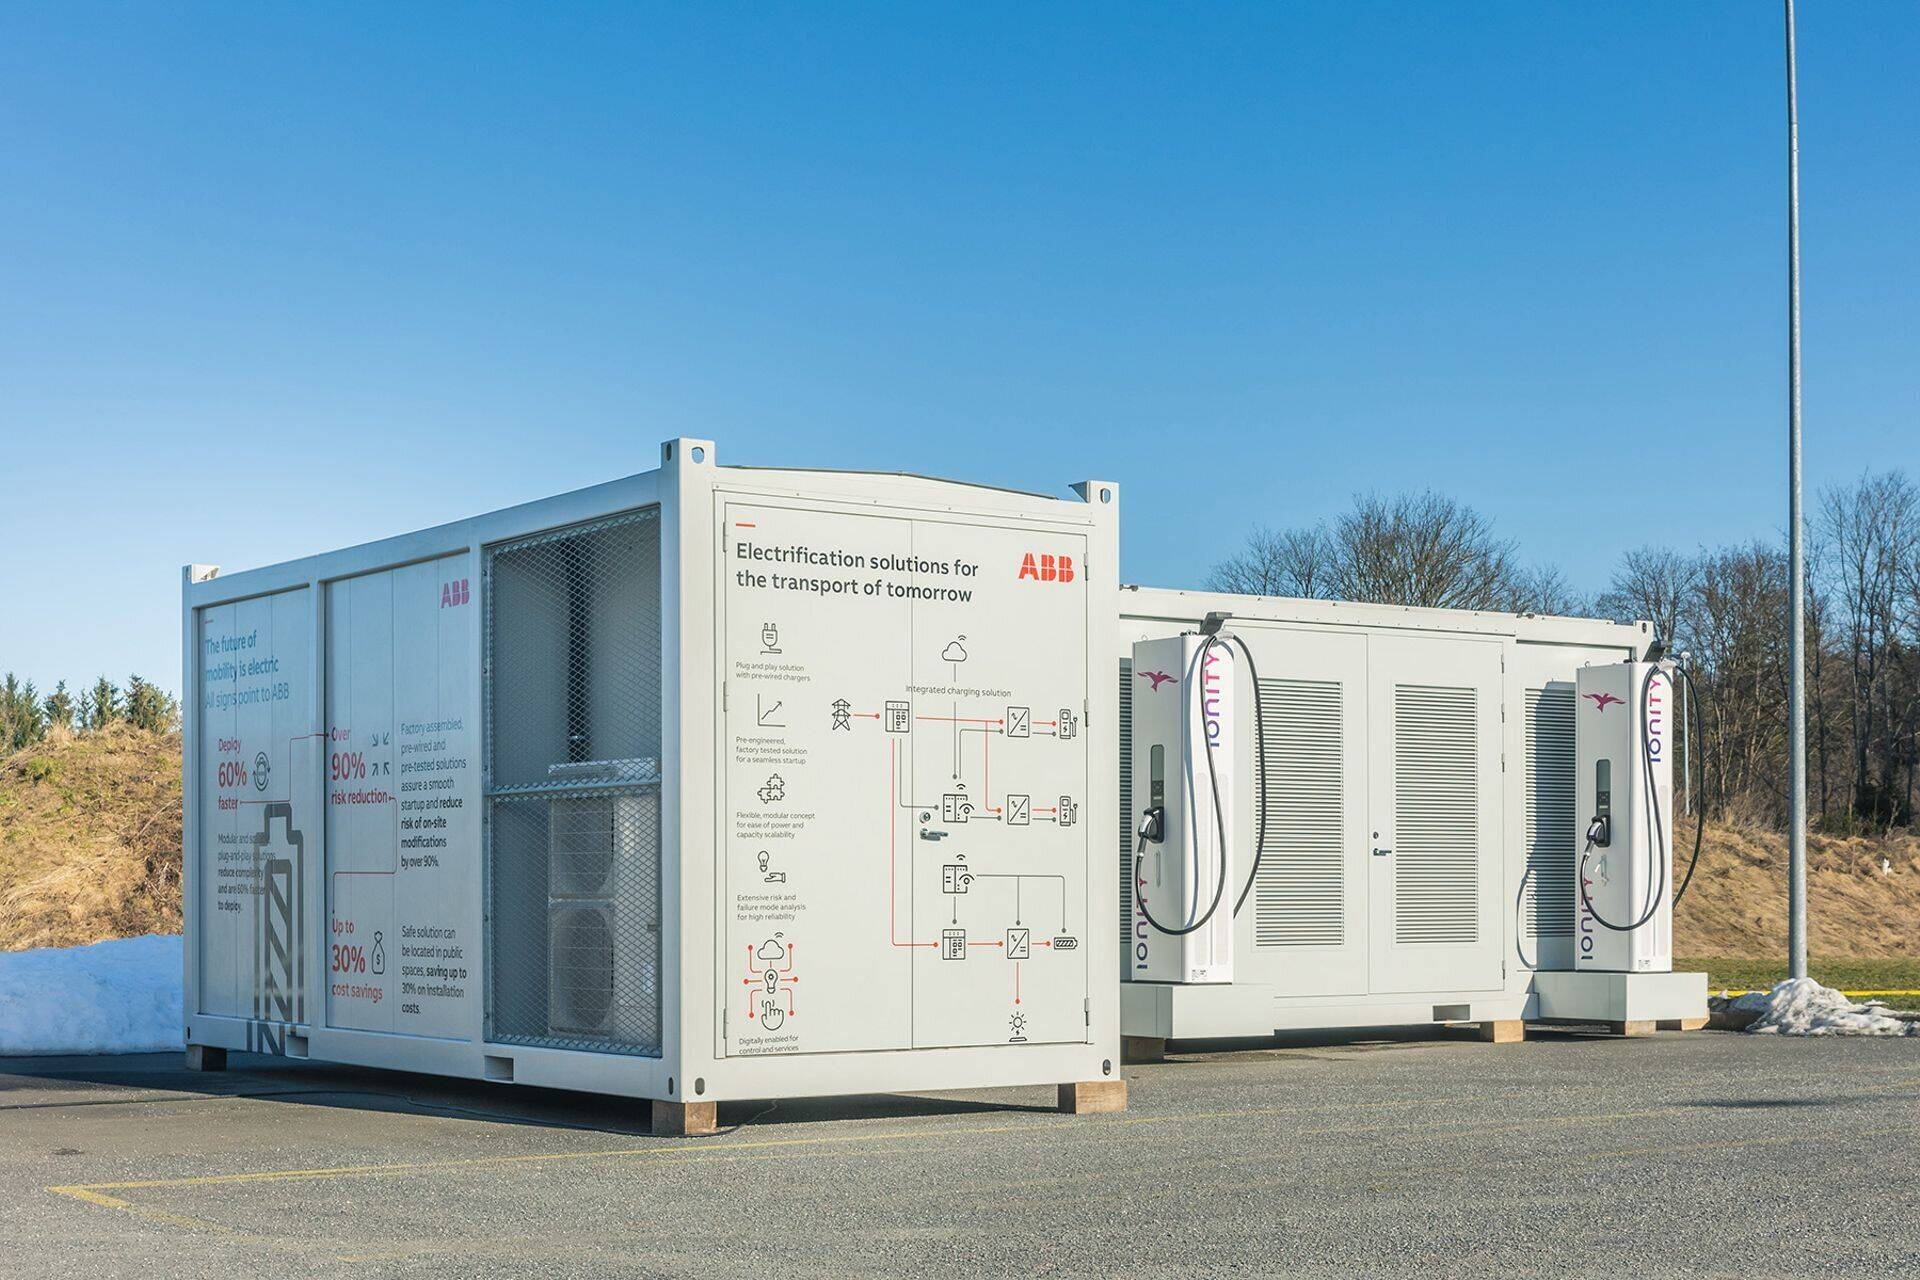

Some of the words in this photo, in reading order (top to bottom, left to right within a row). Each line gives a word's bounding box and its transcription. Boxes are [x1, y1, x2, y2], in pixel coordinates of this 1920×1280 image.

[736, 542, 865, 569] Electrification
[869, 552, 950, 575] solutions
[954, 559, 979, 577] for
[1018, 552, 1075, 583] ABB
[441, 578, 471, 609] ABB
[736, 570, 767, 588] the
[771, 572, 859, 596] transport
[863, 579, 882, 596] of
[886, 583, 973, 603] tomorrow
[205, 638, 219, 655] The
[221, 635, 246, 654] future
[247, 629, 257, 648] of
[206, 662, 237, 682] mobility
[239, 660, 247, 678] is
[248, 655, 278, 676] electric
[736, 661, 750, 671] Plug
[751, 662, 764, 670] and
[764, 662, 778, 672] play
[779, 664, 805, 672] solution
[736, 671, 750, 679] with
[751, 672, 782, 681] pre-wired
[783, 673, 811, 682] chargers
[205, 691, 215, 708] All
[216, 690, 237, 712] signs
[238, 686, 259, 706] point
[261, 686, 271, 703] to
[271, 682, 289, 700] ABB
[905, 684, 945, 698] Integrated
[946, 687, 981, 698] charging
[982, 688, 1012, 698] solution
[1204, 648, 1220, 748] IONITY
[1649, 678, 1661, 763] IONITY
[331, 725, 351, 742] Over
[401, 723, 424, 737] Factory
[218, 736, 241, 755] Deploy
[401, 741, 431, 755] pre-wired
[432, 740, 446, 751] and
[736, 736, 786, 746] Pre-engineered,
[736, 746, 759, 755] factory
[760, 746, 781, 755] tested
[782, 747, 808, 755] solution
[331, 751, 366, 781] 90%
[401, 761, 434, 774] pre-tested
[435, 756, 467, 770] solutions
[736, 755, 746, 763] for
[752, 756, 782, 764] seamless
[783, 757, 806, 766] startup
[218, 760, 247, 787] 60%
[401, 781, 423, 793] assure
[428, 777, 455, 790] smooth
[218, 795, 238, 811] faster
[331, 789, 345, 805] risk
[348, 787, 389, 804] reduction
[401, 798, 425, 813] startup
[425, 796, 439, 810] and
[439, 796, 463, 809] reduce
[401, 819, 413, 830] risk
[414, 816, 422, 830] of
[423, 815, 447, 829] on-site
[736, 811, 762, 820] Flexible,
[762, 811, 789, 819] modular
[789, 812, 815, 821] concept
[736, 821, 747, 829] for
[762, 821, 771, 829] of
[771, 822, 791, 831] power
[791, 821, 804, 829] and
[401, 836, 447, 848] modifications
[736, 831, 763, 840] capacity
[764, 831, 796, 840] scalability
[401, 856, 410, 871] by
[409, 857, 423, 869] over
[218, 867, 235, 878] reduce
[218, 884, 228, 895] and
[736, 894, 769, 902] Extensive
[770, 893, 783, 901] risk
[783, 893, 796, 901] and
[218, 901, 224, 911] to
[736, 903, 759, 911] failure
[779, 903, 806, 912] analysis
[736, 913, 748, 921] for
[748, 913, 764, 922] high
[764, 912, 795, 922] reliability
[1581, 876, 1594, 961] IONITY
[332, 916, 343, 937] Up
[345, 919, 355, 934] to
[401, 924, 416, 939] Safe
[417, 925, 443, 940] solution
[443, 928, 456, 940] can
[332, 943, 366, 974] 30%
[401, 944, 411, 957] be
[411, 944, 435, 958] located
[435, 946, 443, 958] in
[443, 946, 463, 961] public
[401, 965, 425, 979] spaces,
[426, 964, 448, 982] saving
[448, 968, 458, 982] up
[459, 966, 467, 979] to
[332, 984, 350, 997] cost
[351, 983, 383, 1004] savings
[401, 982, 416, 995] 30%
[417, 985, 426, 996] on
[426, 983, 465, 998] installation
[401, 1003, 422, 1016] costs.
[738, 1036, 764, 1046] Digitally
[764, 1036, 788, 1044] enabled
[738, 1046, 761, 1055] control
[774, 1045, 799, 1053] services
